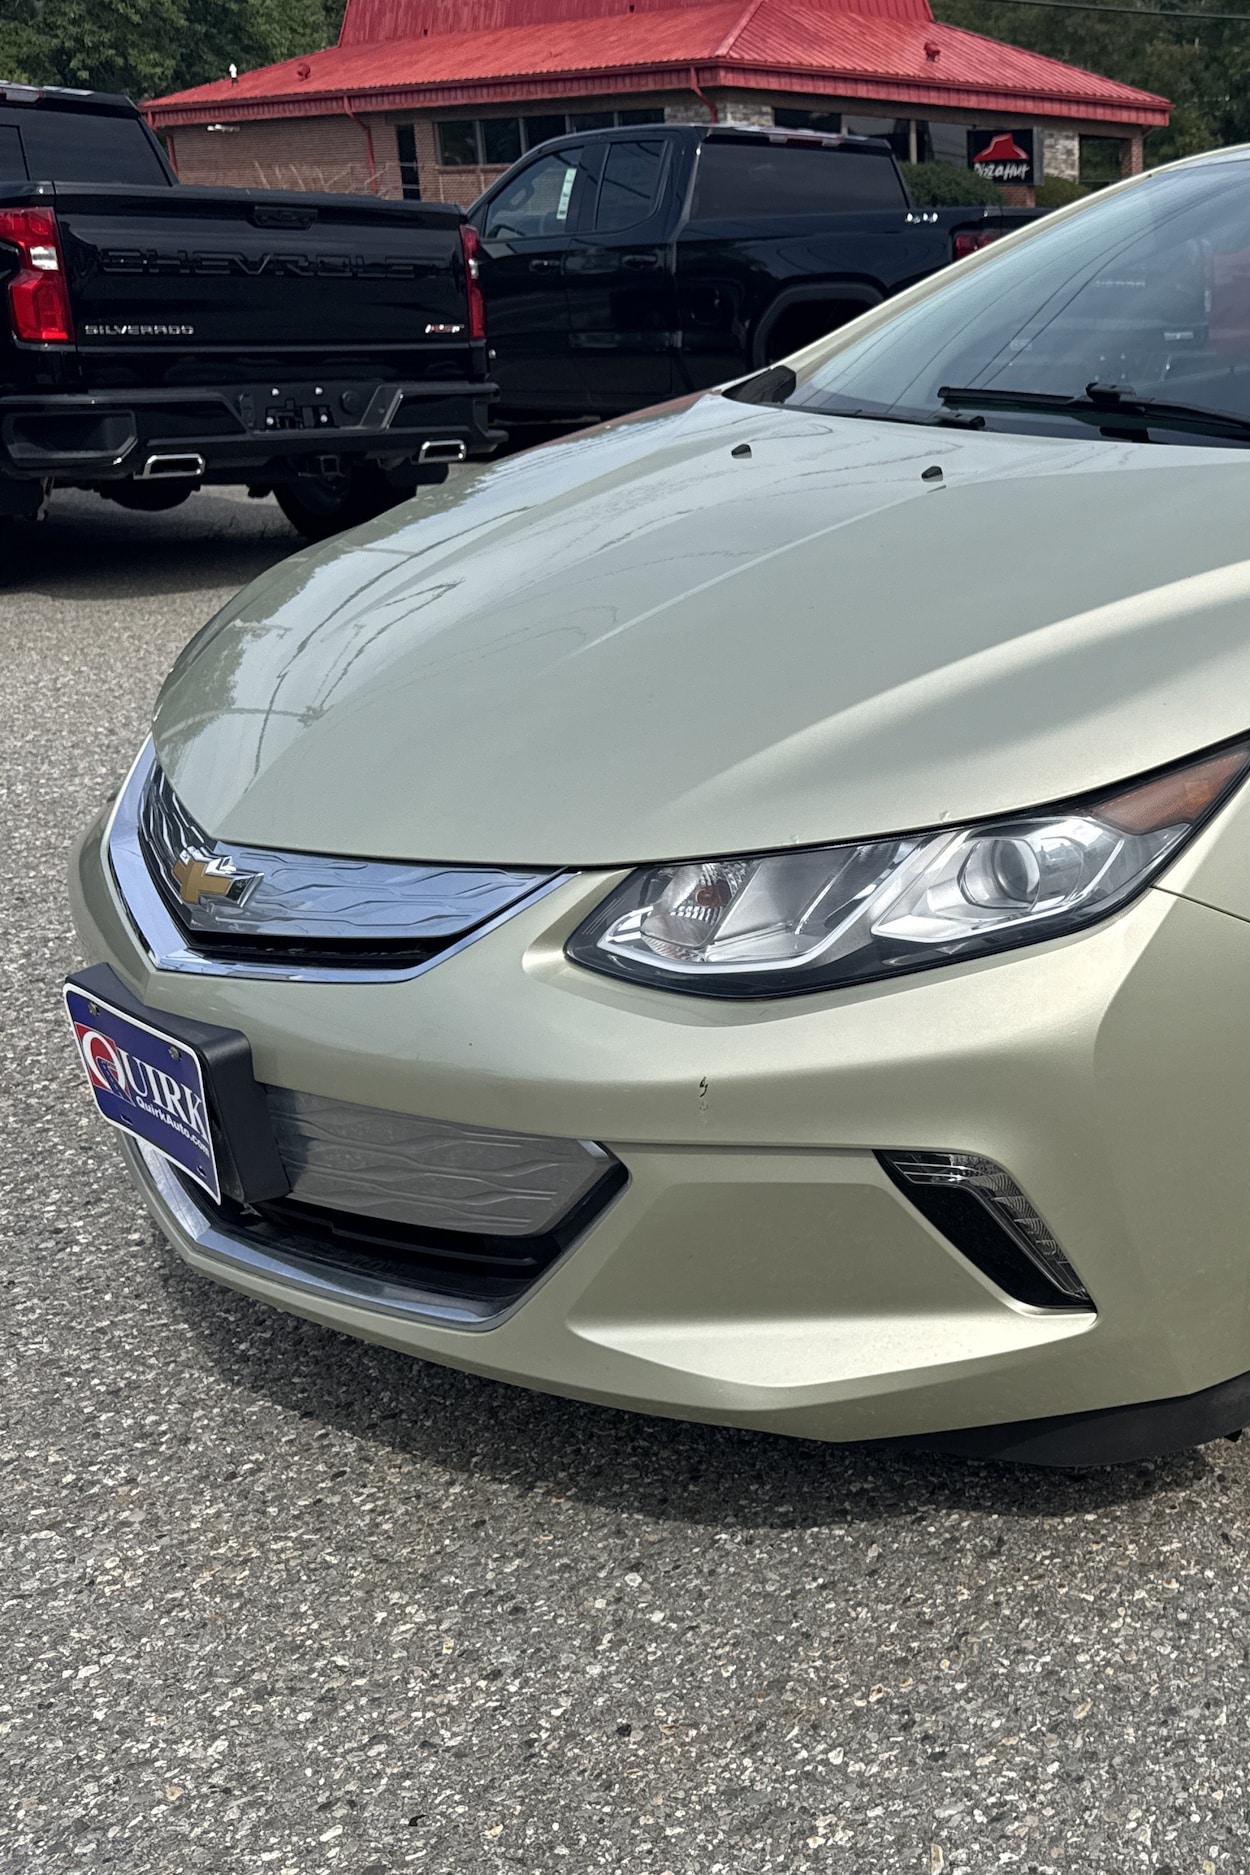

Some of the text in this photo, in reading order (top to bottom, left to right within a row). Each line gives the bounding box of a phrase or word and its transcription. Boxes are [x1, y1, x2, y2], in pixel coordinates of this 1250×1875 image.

[85, 325, 194, 335] SILVERADO
[82, 1030, 210, 1145] QUIRK
[135, 1095, 210, 1158] QuirkAuto.com
